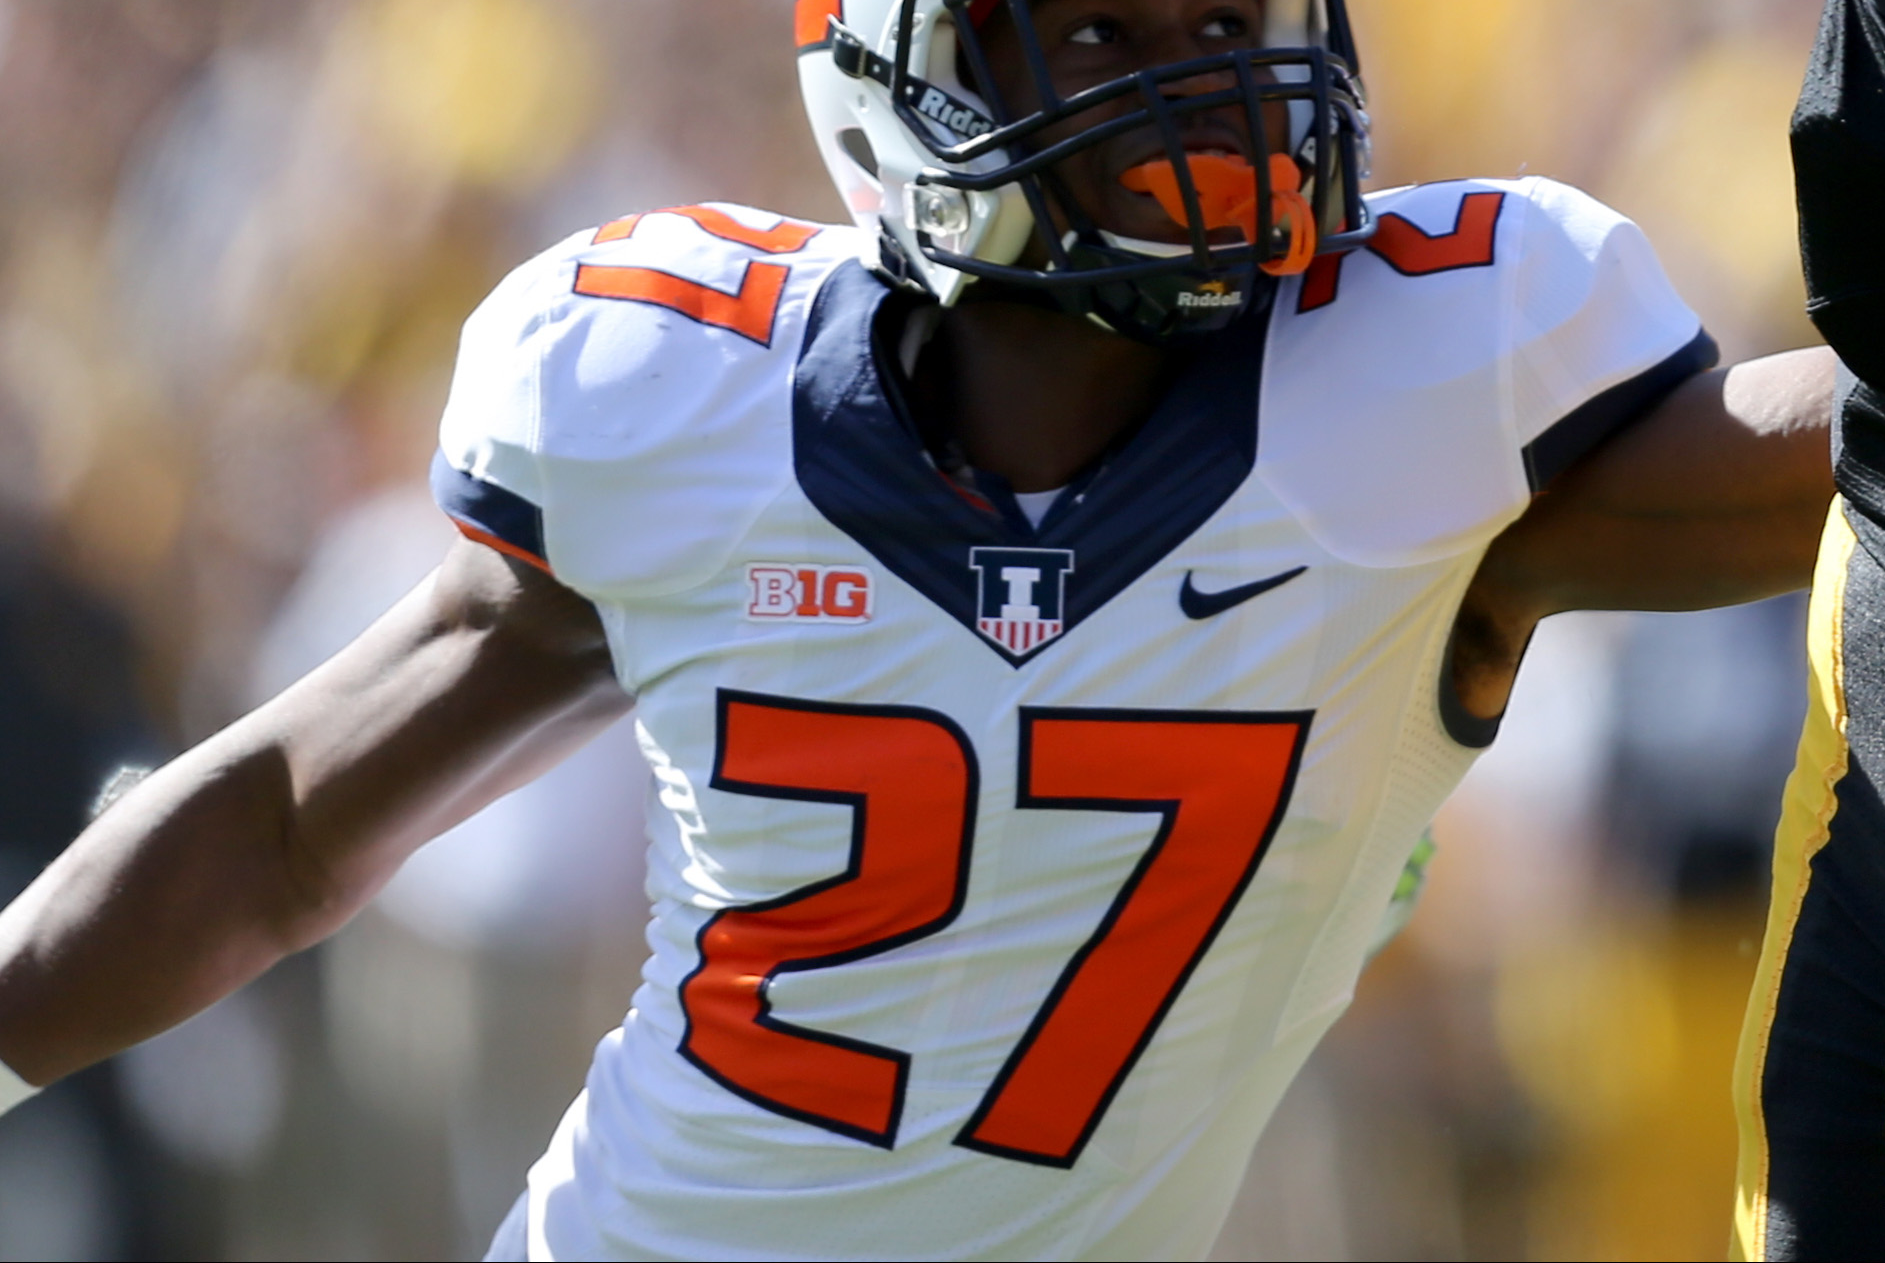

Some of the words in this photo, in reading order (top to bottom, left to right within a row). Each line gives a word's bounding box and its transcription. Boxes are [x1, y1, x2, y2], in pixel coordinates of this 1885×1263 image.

[917, 86, 993, 138] Ridd
[1176, 289, 1244, 307] Riddell
[677, 686, 1316, 1170] 27
